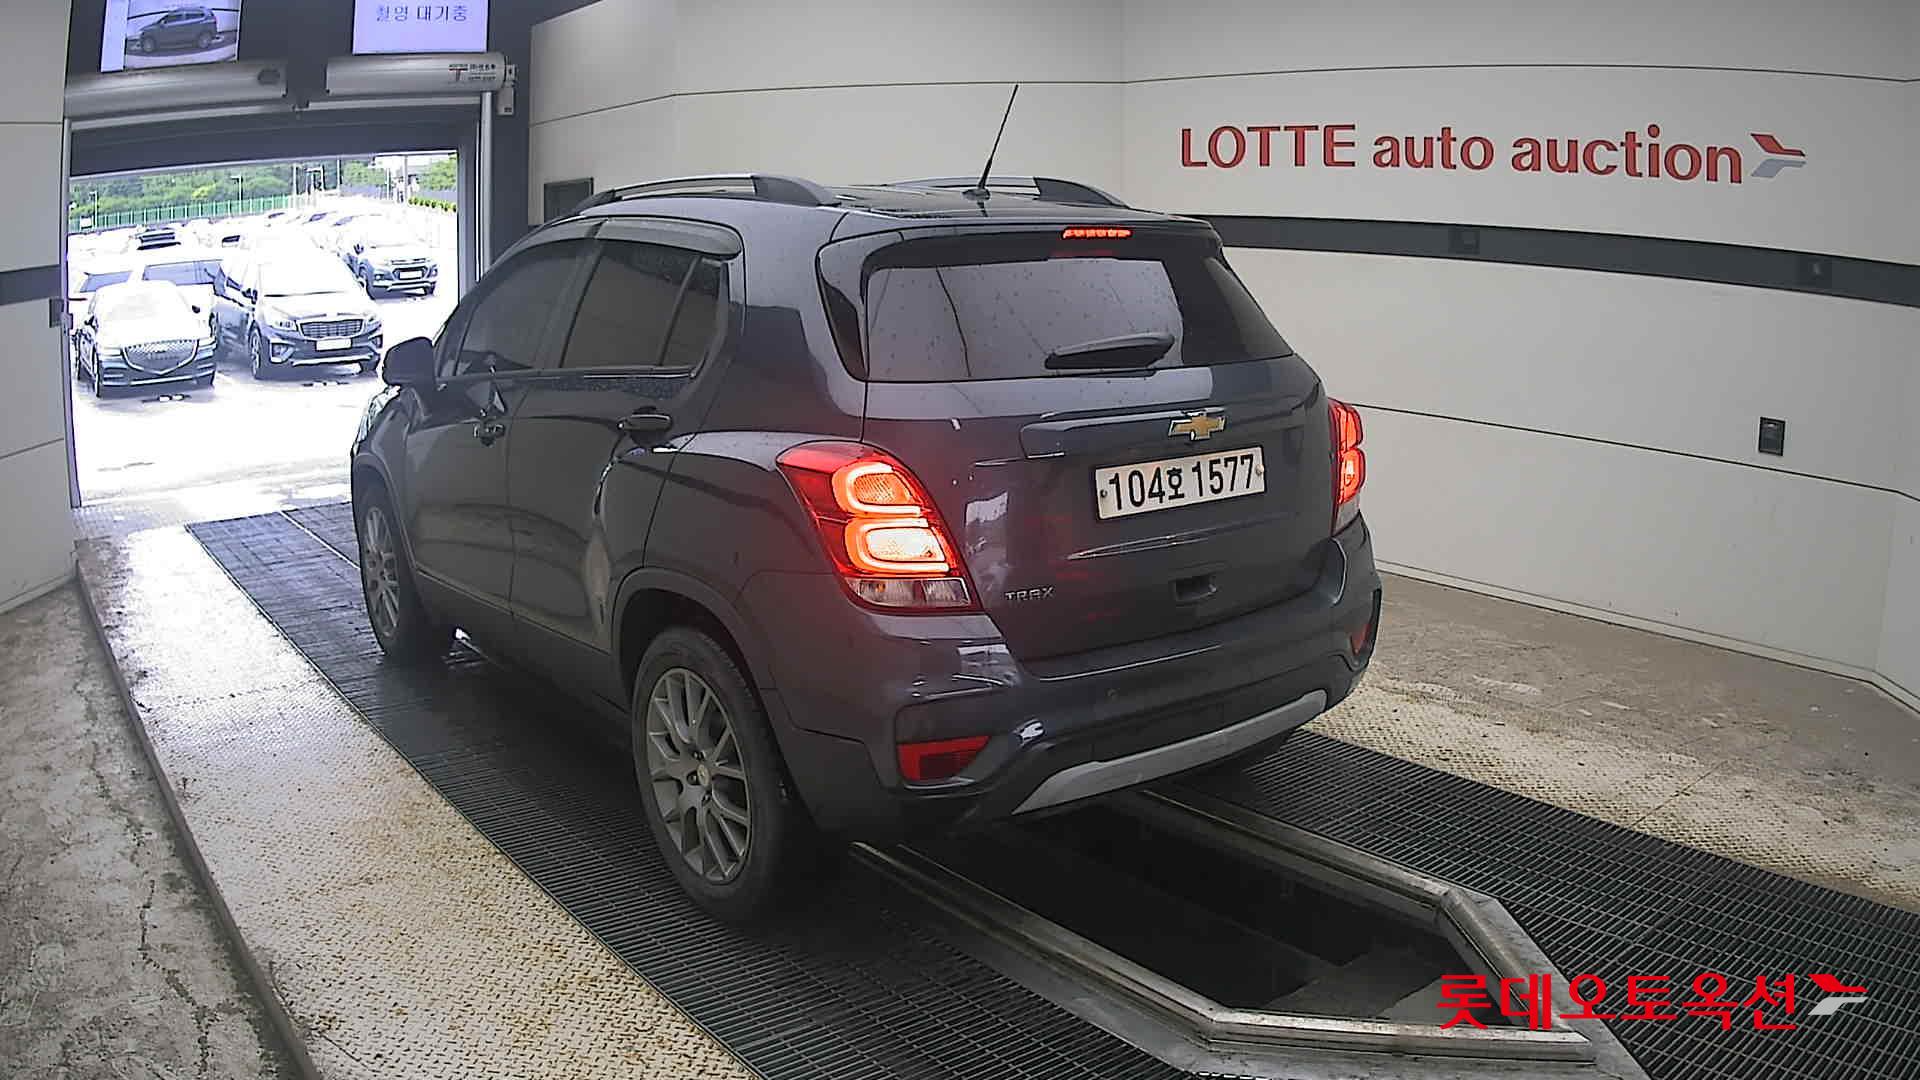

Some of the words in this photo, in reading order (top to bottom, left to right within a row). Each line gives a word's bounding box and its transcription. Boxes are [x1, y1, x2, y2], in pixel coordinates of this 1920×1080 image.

[417, 5, 468, 22] 대기중
[1180, 123, 1356, 169] LOTTE
[1372, 126, 1495, 171] auto
[1511, 123, 1744, 185] auction
[1108, 465, 1185, 511] 104호
[1191, 453, 1255, 498] 1577
[1005, 586, 1054, 602] TRAX
